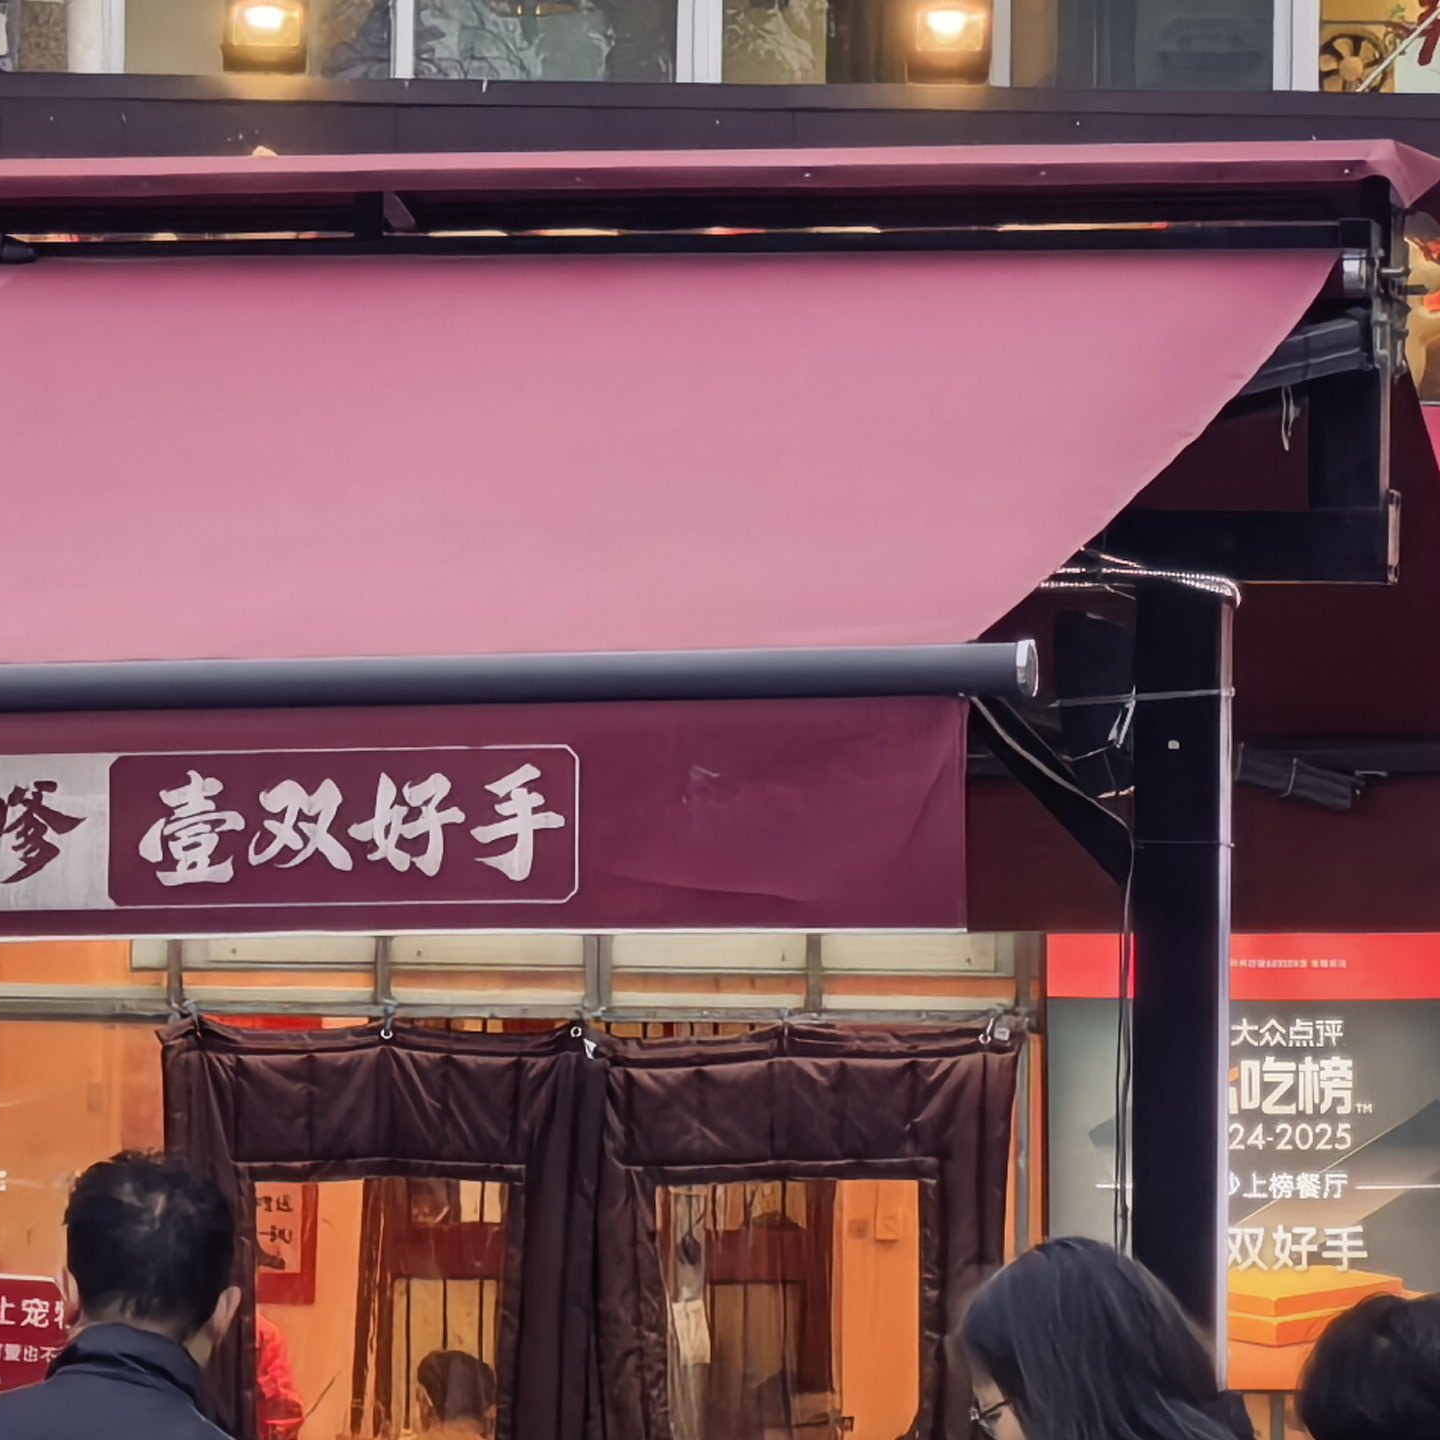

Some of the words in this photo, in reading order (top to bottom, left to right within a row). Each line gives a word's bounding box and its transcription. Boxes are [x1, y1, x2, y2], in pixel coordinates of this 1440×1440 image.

[137, 764, 565, 886] 壹双好手
[1230, 1018, 1344, 1048] 大众点评
[1228, 1056, 1353, 1116] 吃榜
[1228, 1224, 1368, 1272] 双好手
